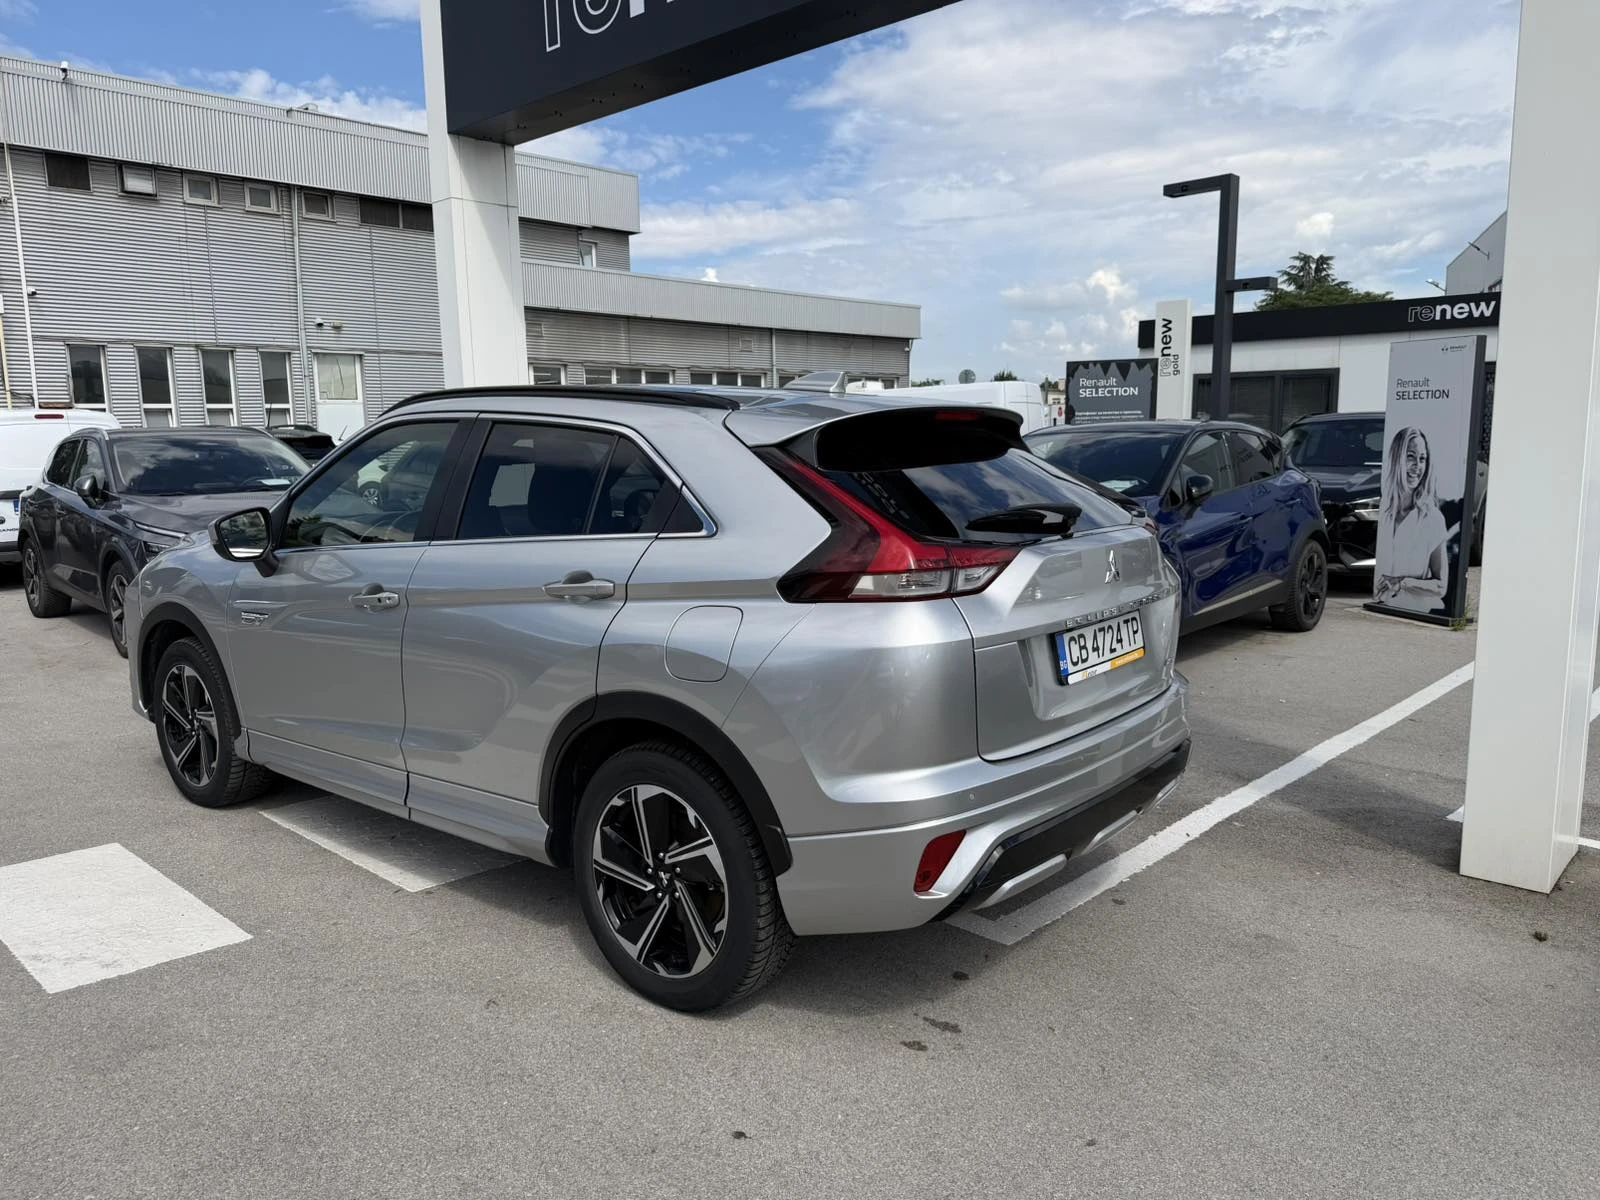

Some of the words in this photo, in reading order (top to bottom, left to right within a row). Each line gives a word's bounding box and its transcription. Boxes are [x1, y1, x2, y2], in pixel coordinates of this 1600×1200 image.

[1408, 300, 1496, 322] renew
[1160, 318, 1172, 377] renew
[1172, 354, 1180, 376] gold
[1079, 377, 1117, 387] Renault
[1396, 377, 1430, 388] Renault
[1079, 386, 1139, 398] SELECTION
[1395, 389, 1450, 401] SELECTION
[1068, 633, 1089, 667] CB
[1092, 621, 1123, 658] 4724
[1123, 616, 1139, 647] TP
